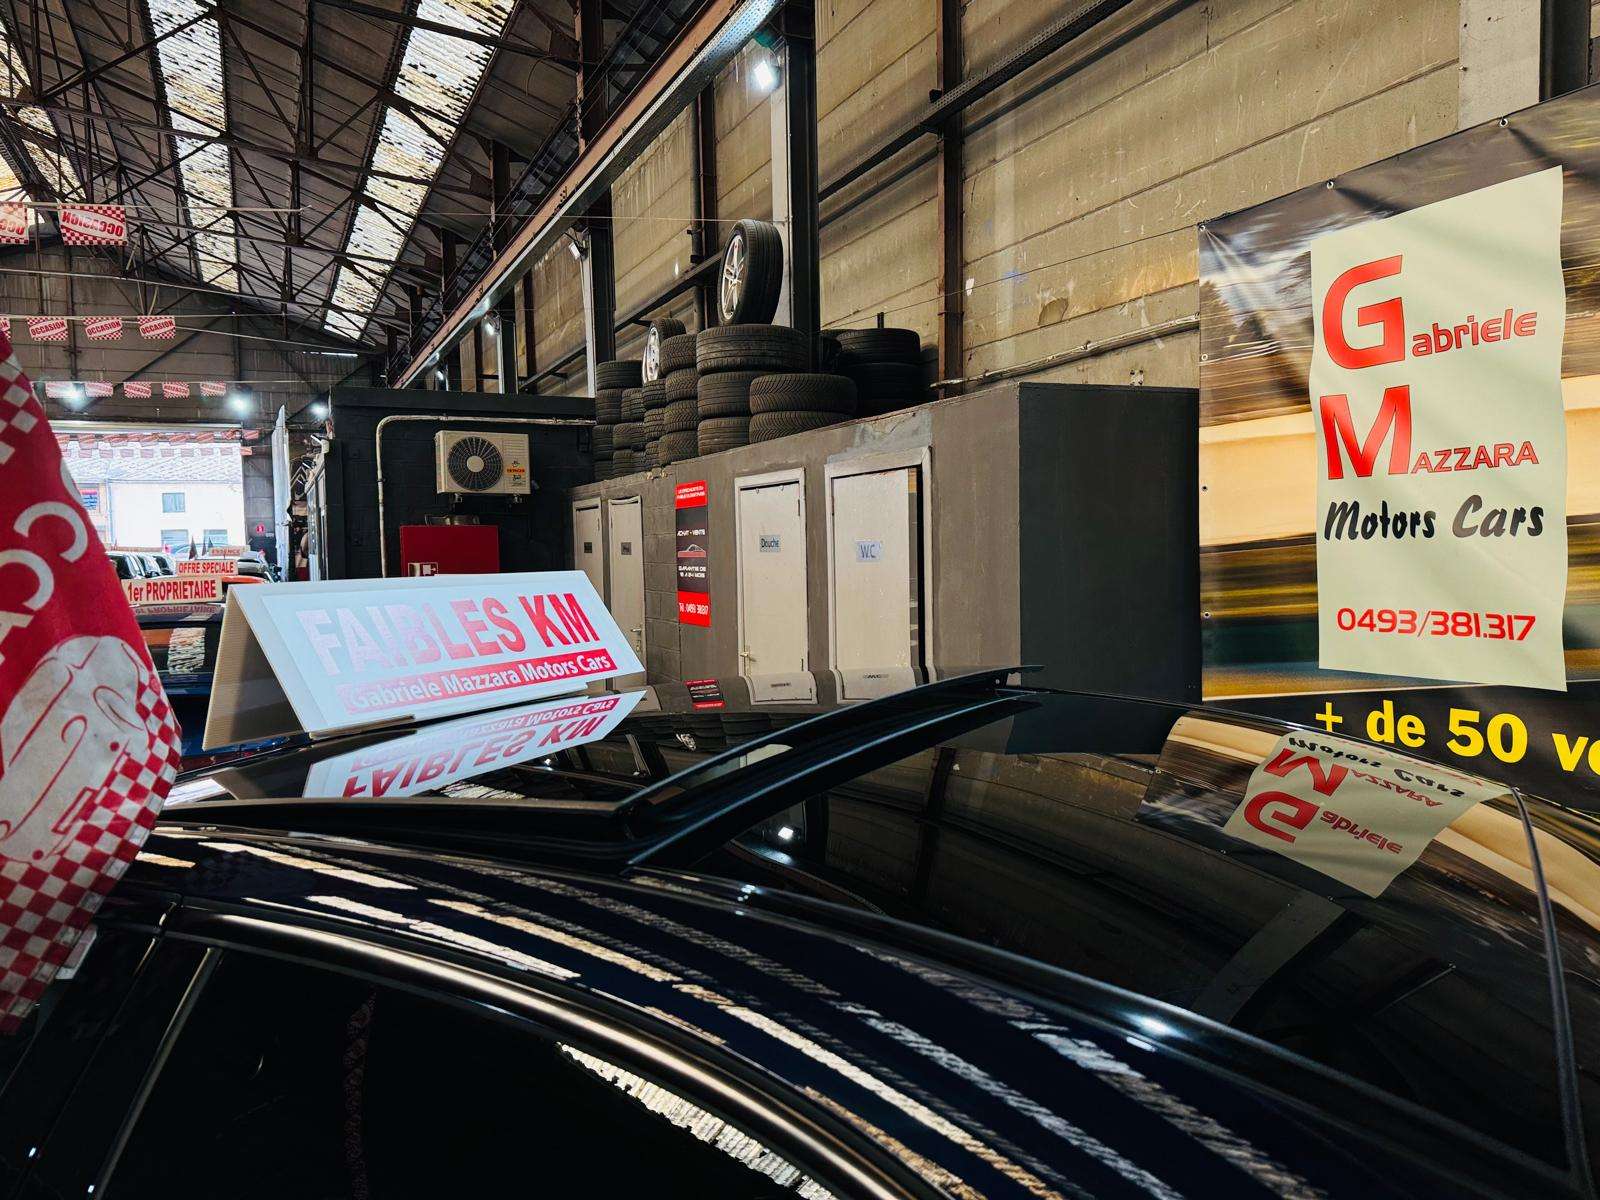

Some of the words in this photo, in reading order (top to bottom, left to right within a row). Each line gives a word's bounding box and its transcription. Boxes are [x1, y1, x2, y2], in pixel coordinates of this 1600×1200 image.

[31, 320, 67, 336] OCCASION
[87, 320, 122, 336] OCCASION
[141, 320, 175, 335] OCCASION
[1322, 254, 1537, 369] Gabriele
[1320, 384, 1539, 480] MAZZARA
[1324, 500, 1437, 541] Motors
[1452, 494, 1544, 538] Cars
[179, 562, 201, 574] OFFRE
[202, 562, 234, 573] SPECIALE
[128, 582, 144, 601] 1er
[146, 580, 217, 601] PROPRIETAIRE
[297, 596, 527, 676] FAIBLES
[519, 593, 601, 648] KM
[1336, 607, 1537, 641] 0493/381.317
[348, 680, 441, 711] Gabriele
[445, 667, 520, 693] Mazzara
[522, 657, 579, 681] Motors
[580, 652, 612, 672] Cars
[1366, 699, 1426, 748] de
[1446, 707, 1529, 764] 50
